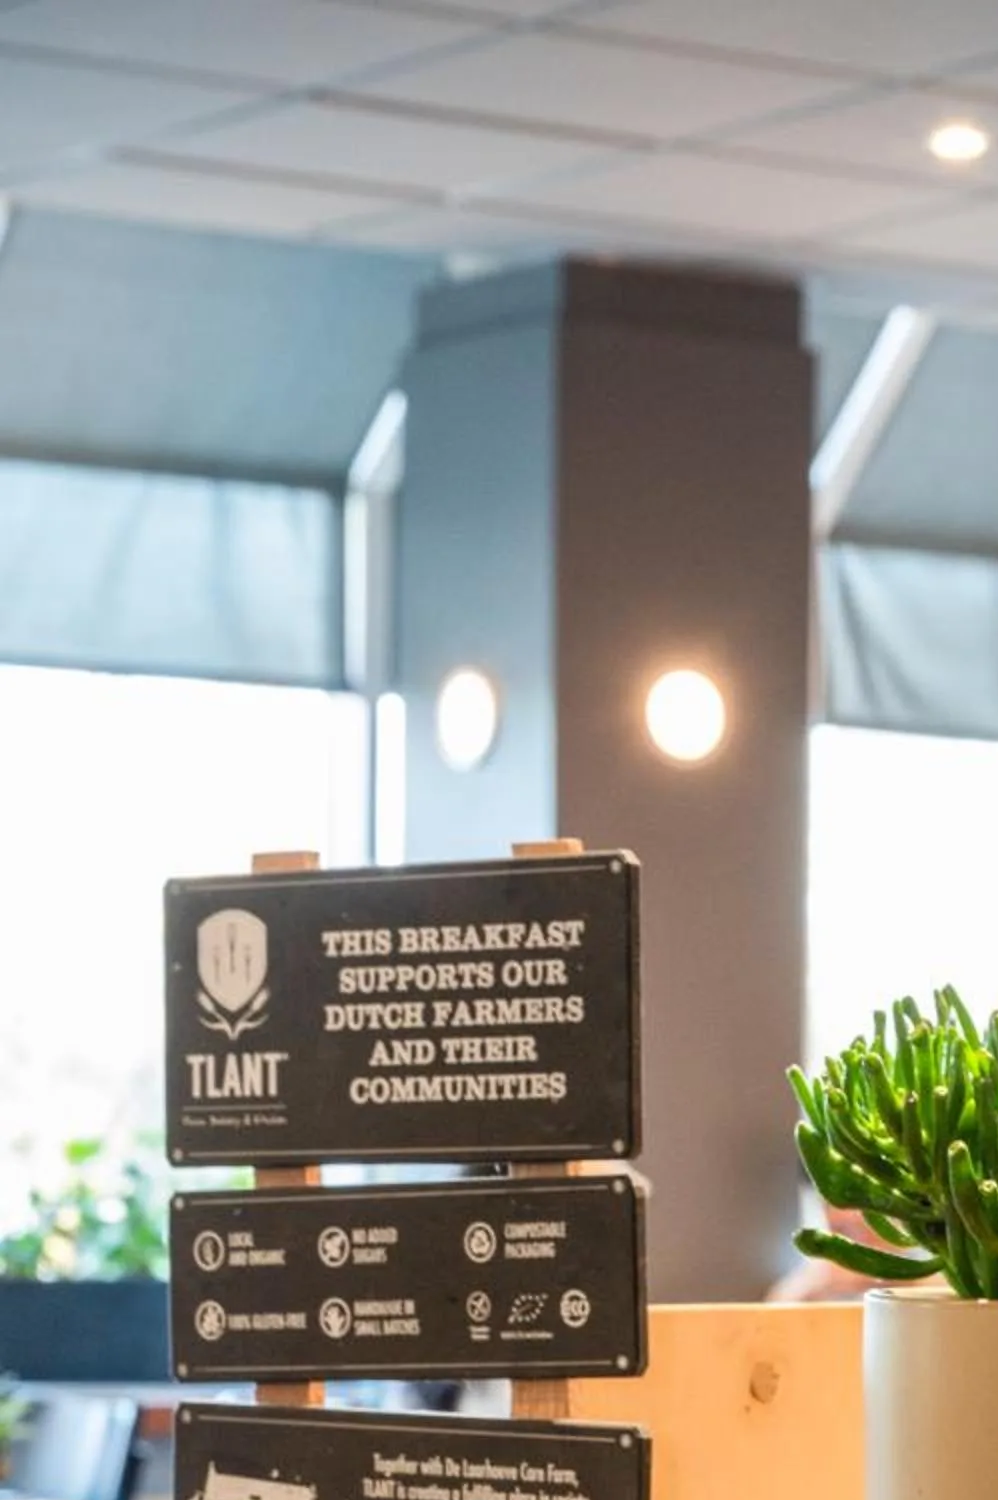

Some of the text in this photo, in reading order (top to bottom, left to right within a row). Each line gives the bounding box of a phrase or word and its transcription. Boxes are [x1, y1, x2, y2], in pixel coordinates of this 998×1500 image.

[321, 920, 585, 958] THIS BREAKFAST
[338, 960, 568, 994] SUPPORTS OUR
[323, 996, 585, 1031] DUTCH FARMERS
[368, 1035, 538, 1067] AND THEIR
[186, 1053, 283, 1098] TLANT
[348, 1072, 568, 1104] COMMUNITIES
